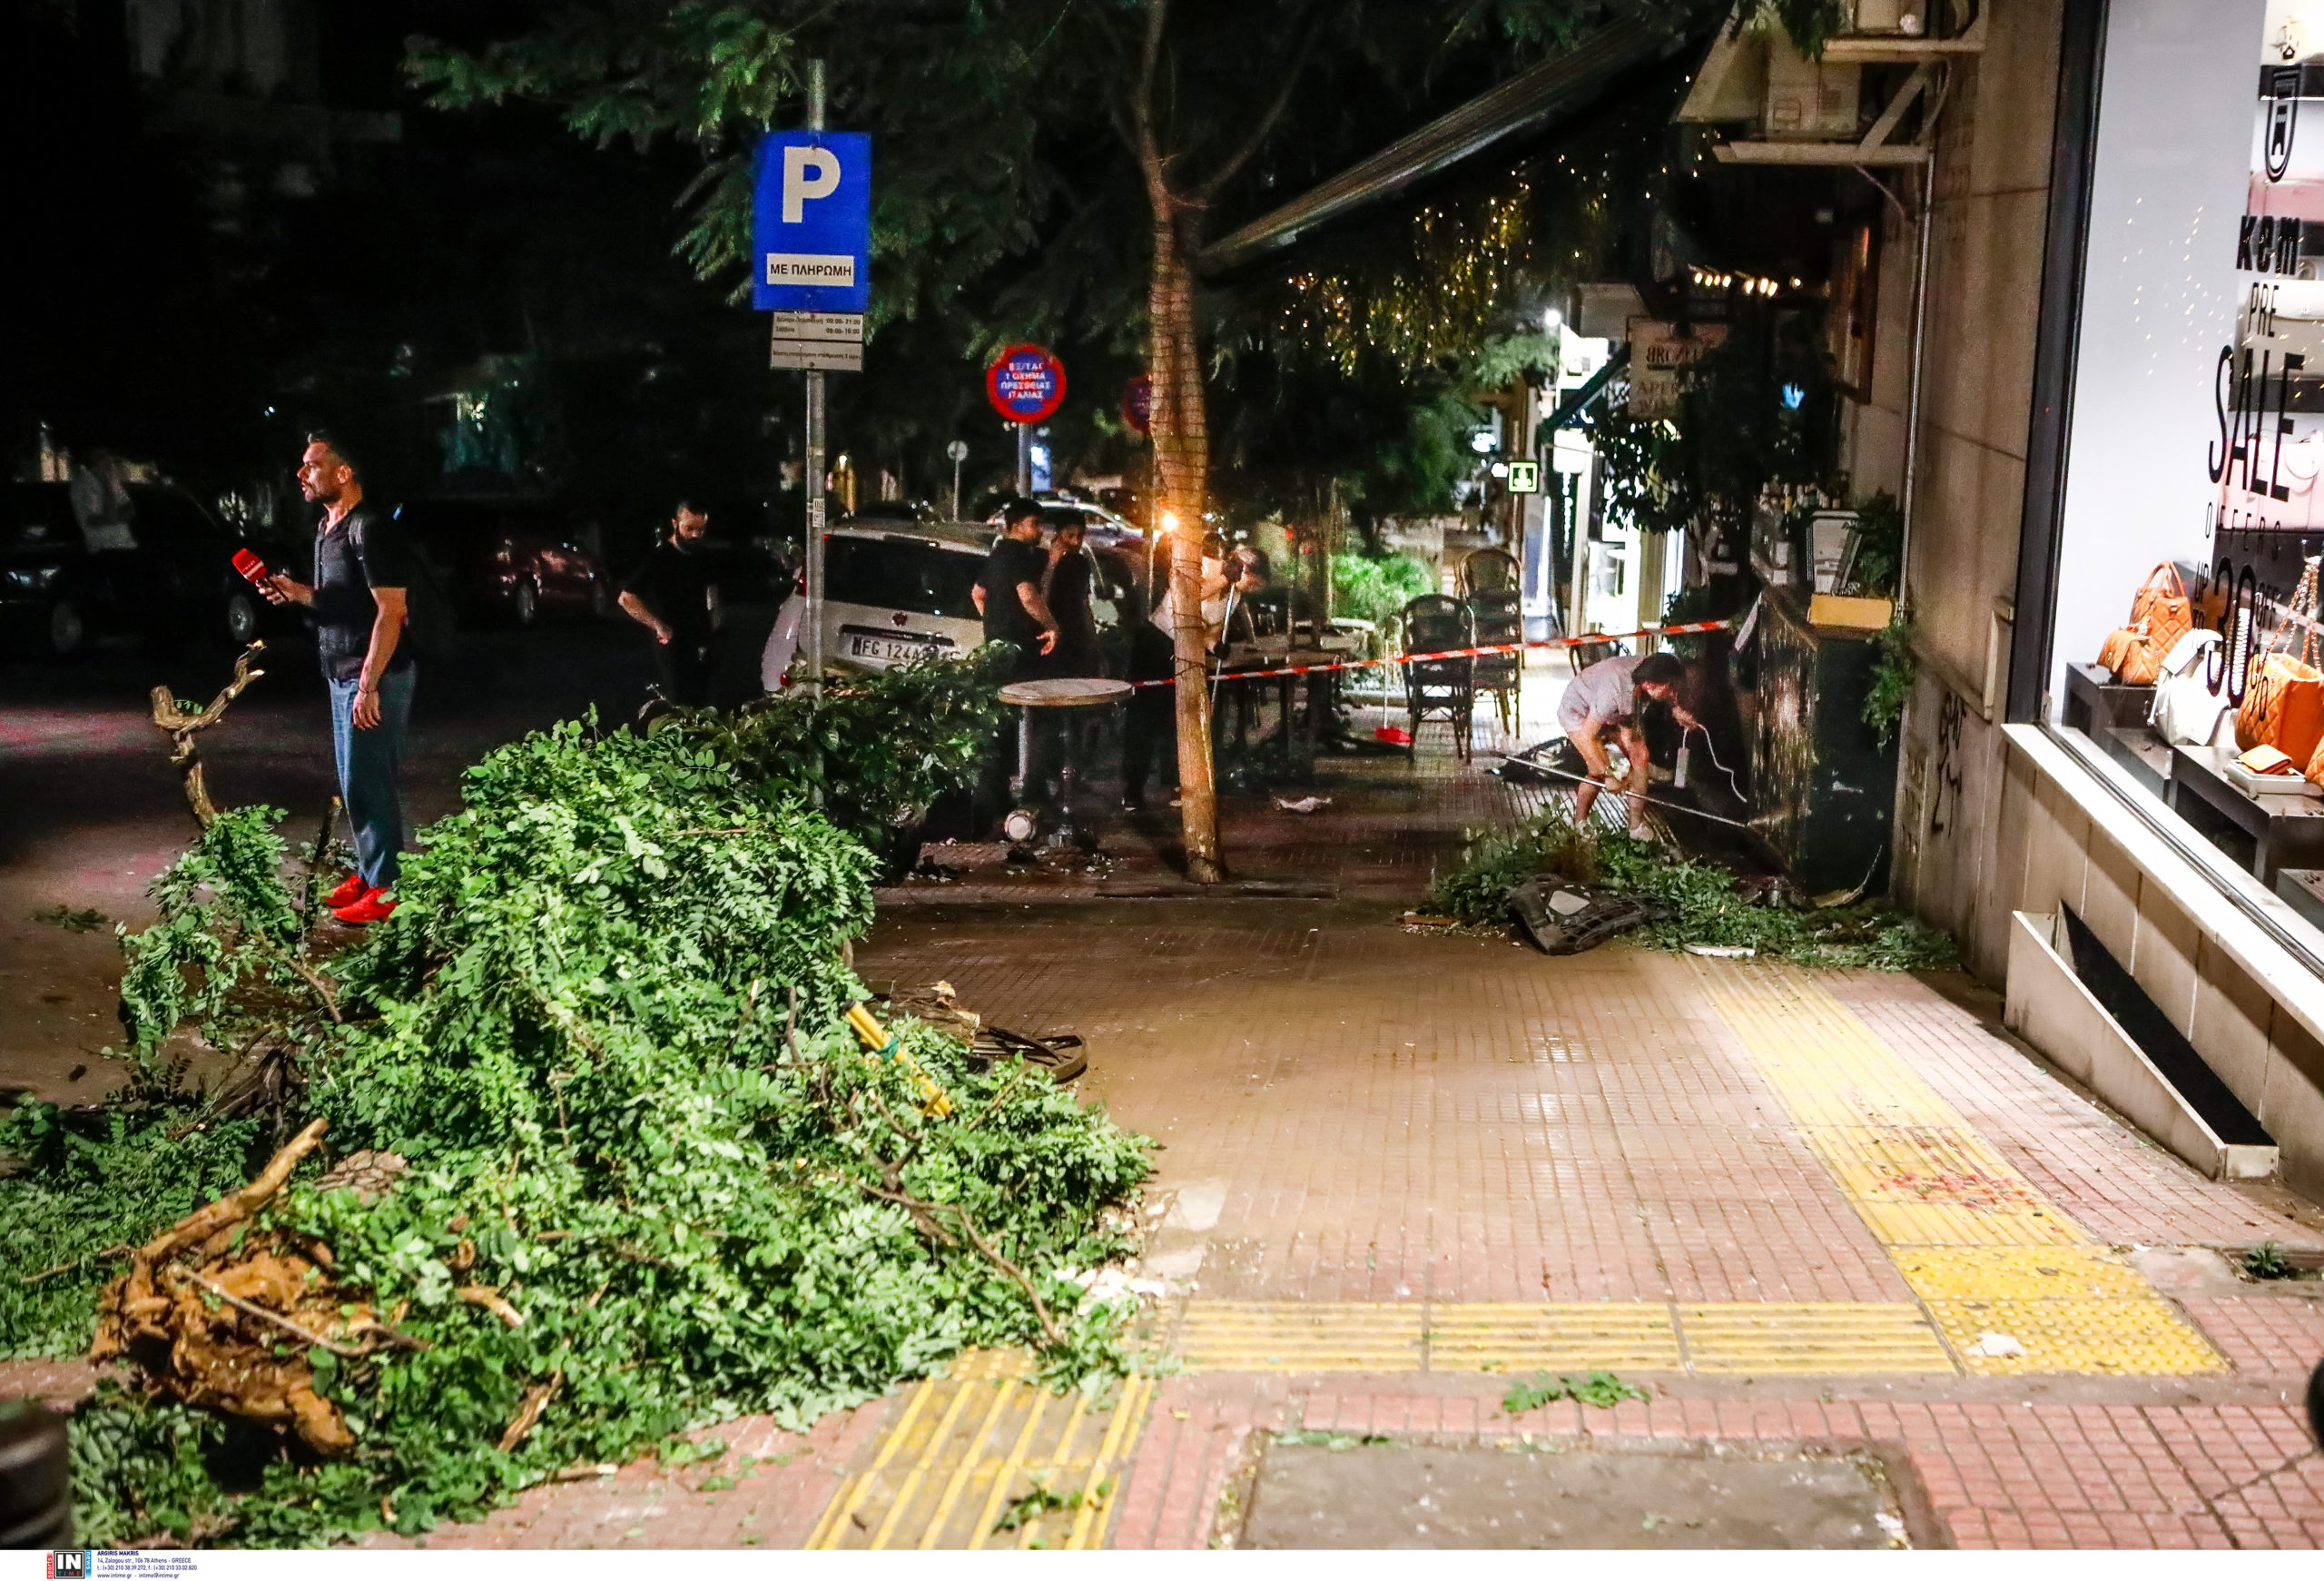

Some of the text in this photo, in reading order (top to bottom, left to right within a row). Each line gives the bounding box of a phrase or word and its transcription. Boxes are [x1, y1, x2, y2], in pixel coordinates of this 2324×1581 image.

[783, 146, 841, 222] P
[770, 263, 852, 277] ΜΕ ΠΛΗΡΩΜΗ
[2247, 282, 2280, 338] PRE
[2208, 344, 2306, 503] SALE
[2205, 501, 2281, 562] OFFERS
[2193, 560, 2210, 604] UP
[862, 639, 926, 661] FG 124A
